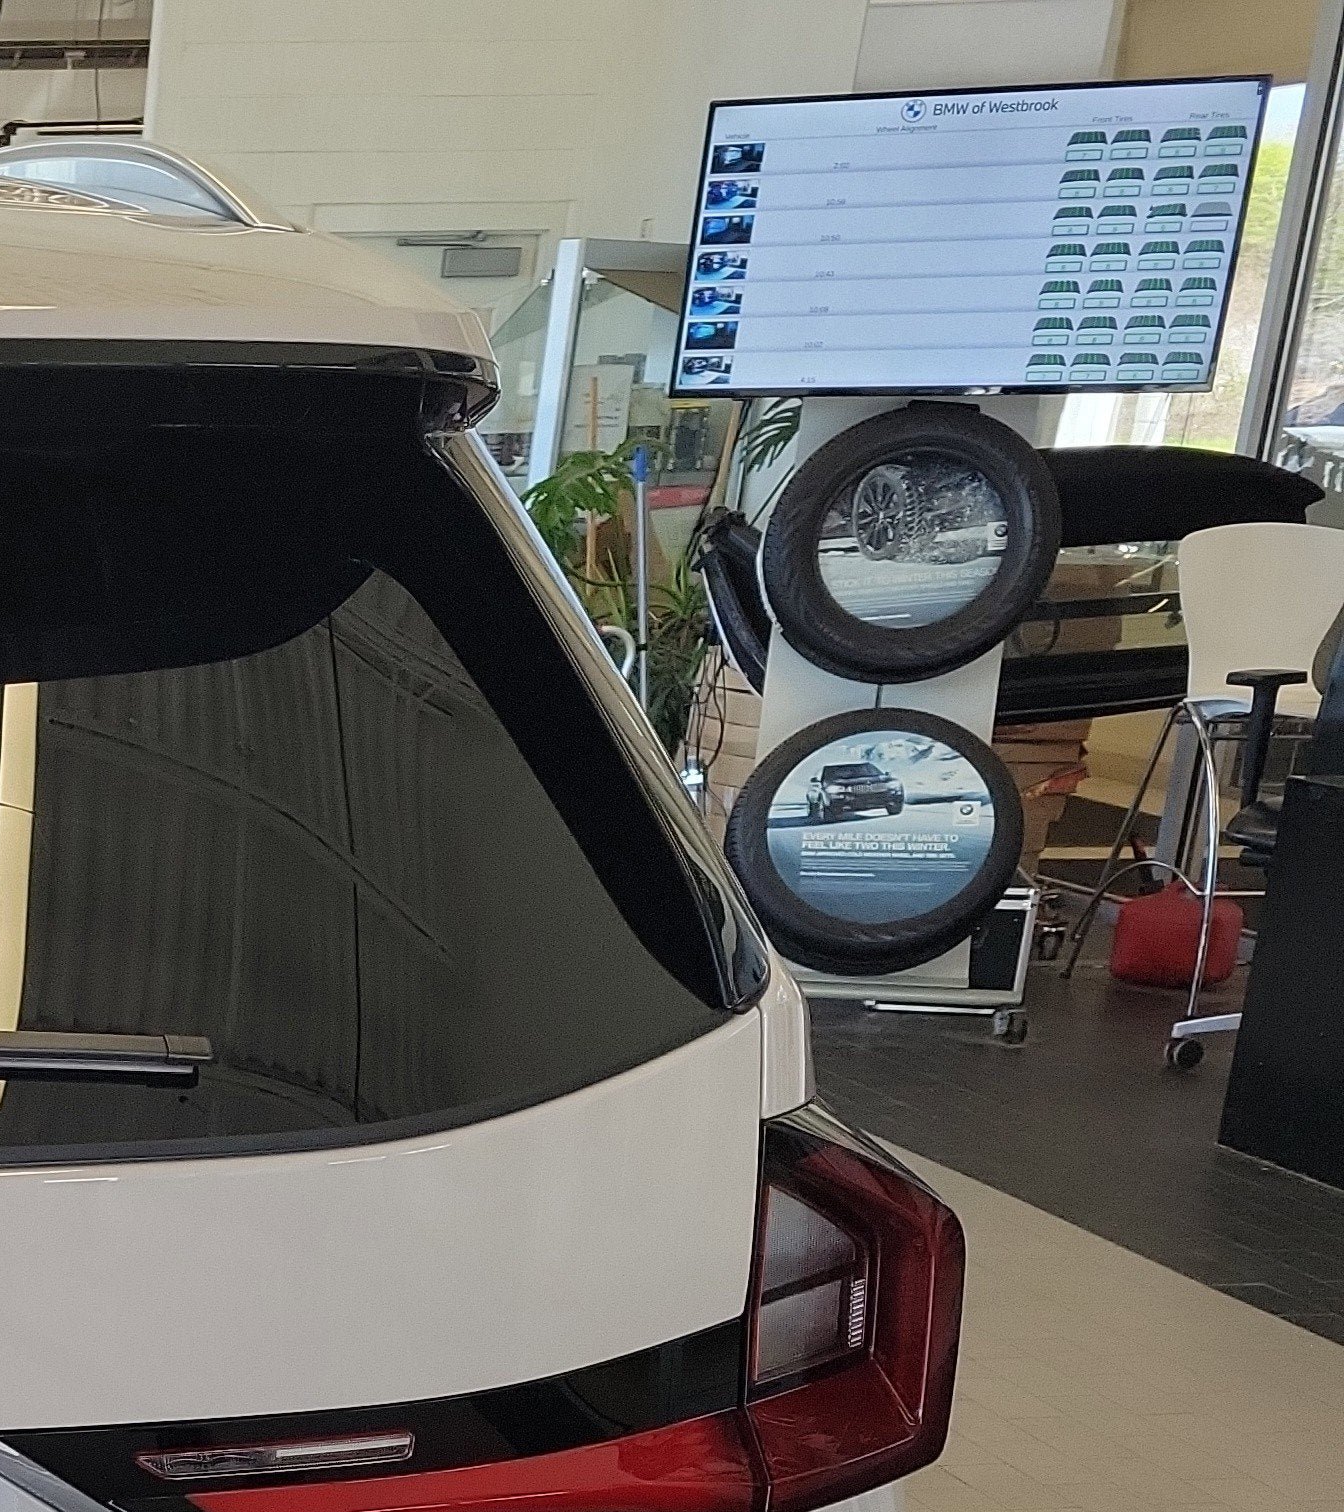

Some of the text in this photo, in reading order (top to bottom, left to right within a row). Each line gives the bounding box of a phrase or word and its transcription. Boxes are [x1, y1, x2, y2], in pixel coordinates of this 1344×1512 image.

[933, 98, 1060, 116] BMW of Westbrook
[802, 832, 959, 843] EVERY MILE DOESN'T HAVE TO
[801, 841, 829, 849] FEEL
[830, 841, 853, 850] LIKE
[854, 841, 879, 850] TWO
[881, 842, 906, 850] THIS
